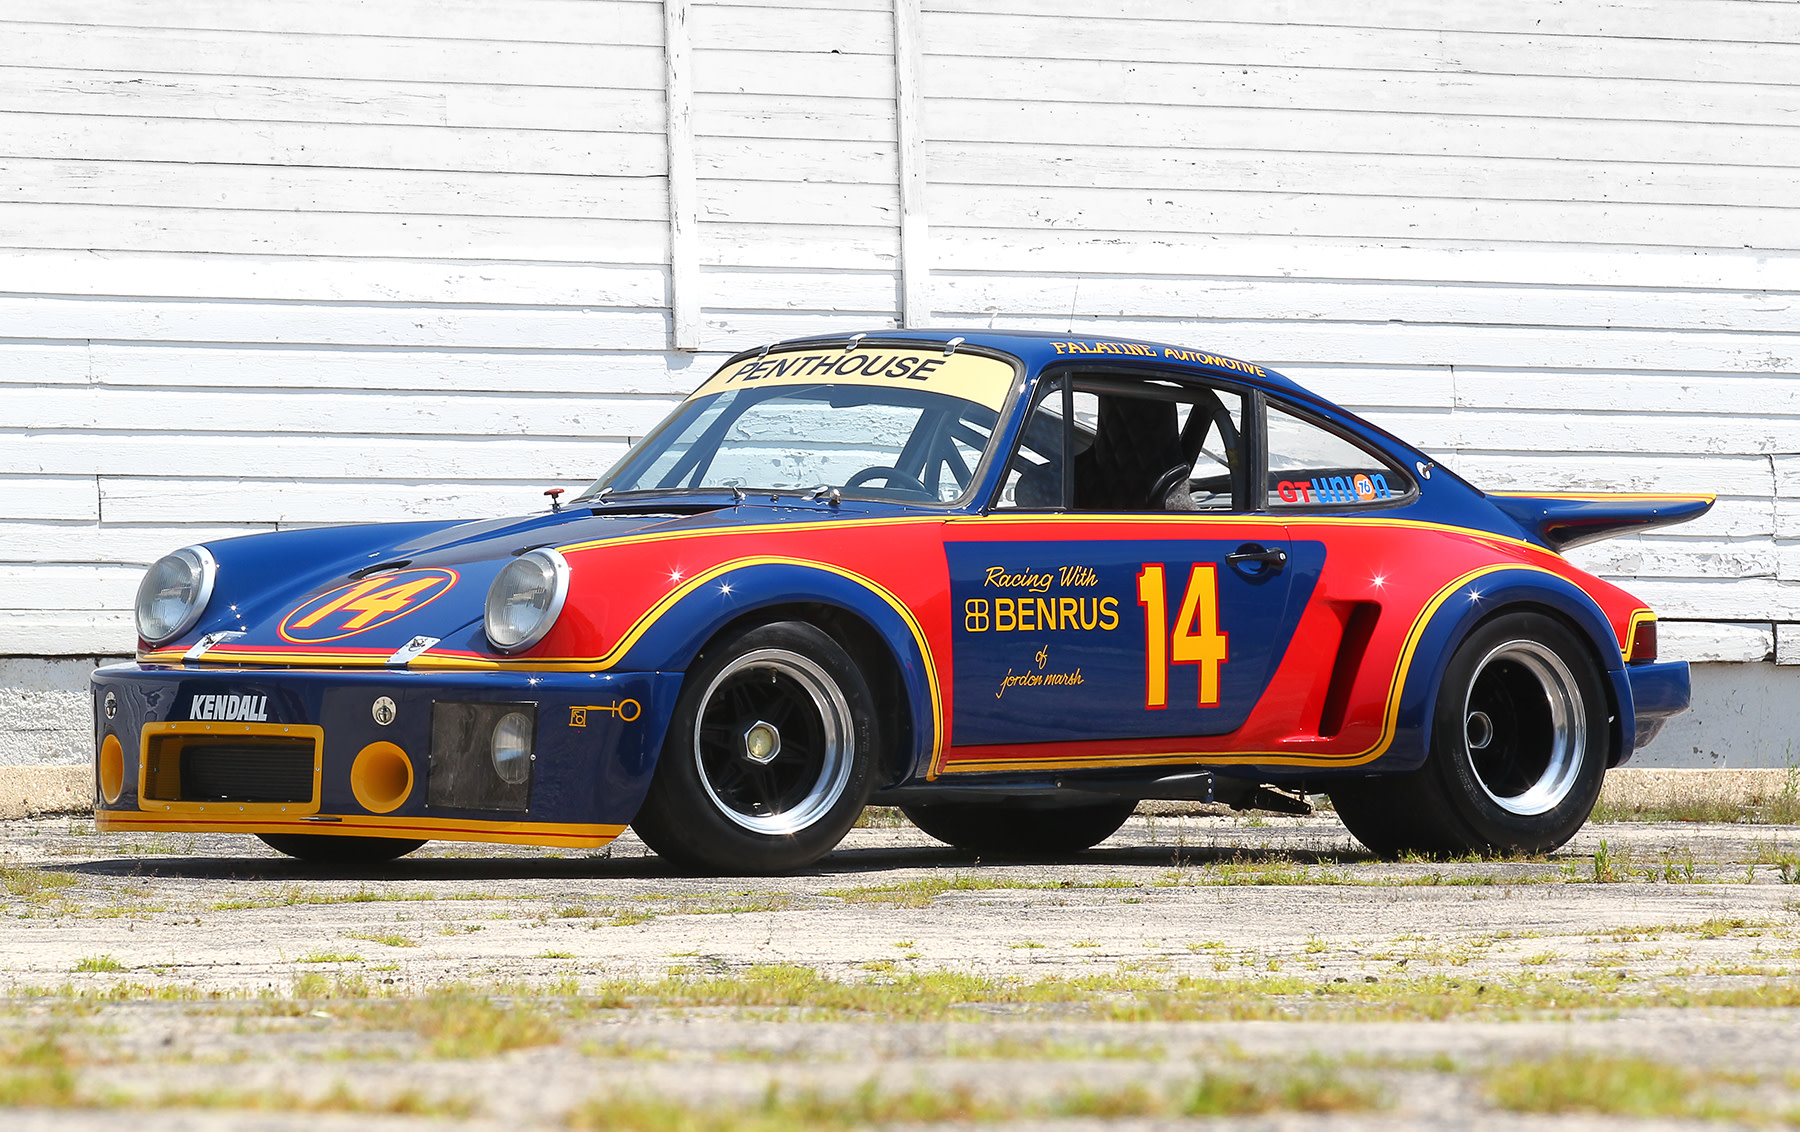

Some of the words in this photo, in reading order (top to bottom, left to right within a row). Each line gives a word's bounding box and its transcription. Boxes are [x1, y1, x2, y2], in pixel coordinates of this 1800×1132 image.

[726, 354, 947, 384] PENTHOUSE
[1050, 341, 1158, 358] PALATINE
[1164, 348, 1268, 379] AUTOMOTIVE
[1276, 480, 1312, 503] GT
[984, 565, 1054, 593] Racing
[1058, 564, 1100, 587] With
[288, 575, 451, 630] 14
[995, 596, 1120, 632] BENRUS
[1135, 562, 1230, 711] 14
[1034, 644, 1049, 670] of
[995, 667, 1043, 699] jordon
[1043, 667, 1085, 687] marsh
[190, 694, 268, 721] KENDALL
